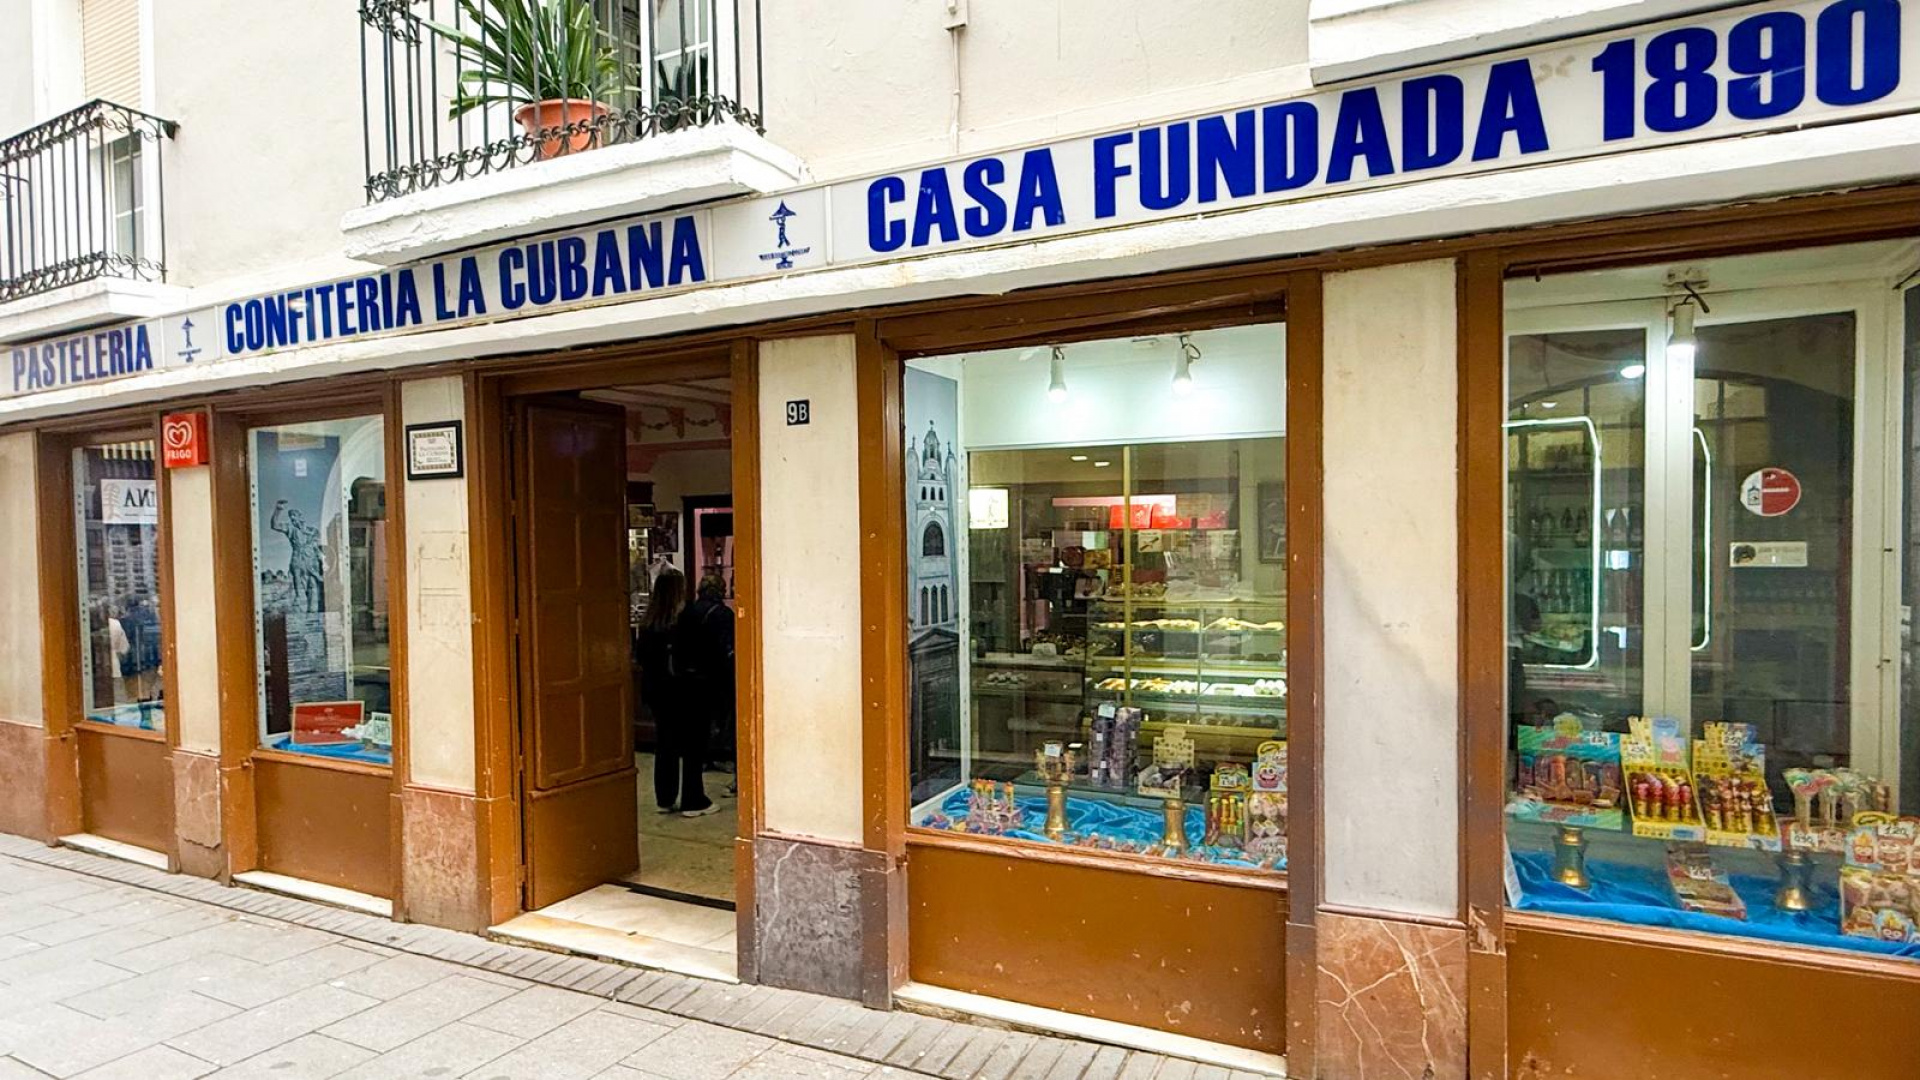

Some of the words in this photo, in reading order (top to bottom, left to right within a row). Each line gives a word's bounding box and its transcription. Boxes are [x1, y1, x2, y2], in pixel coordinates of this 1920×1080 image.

[867, 147, 1066, 253] CASA
[1093, 58, 1549, 219] FUNDADA
[1592, 0, 1900, 142] 1890
[226, 268, 422, 354] CONFITERIA
[434, 256, 487, 321] LA
[499, 215, 706, 309] CUBANA
[13, 323, 154, 392] PASTELERIA
[788, 402, 807, 423] 9B
[167, 449, 192, 459] FRIGO
